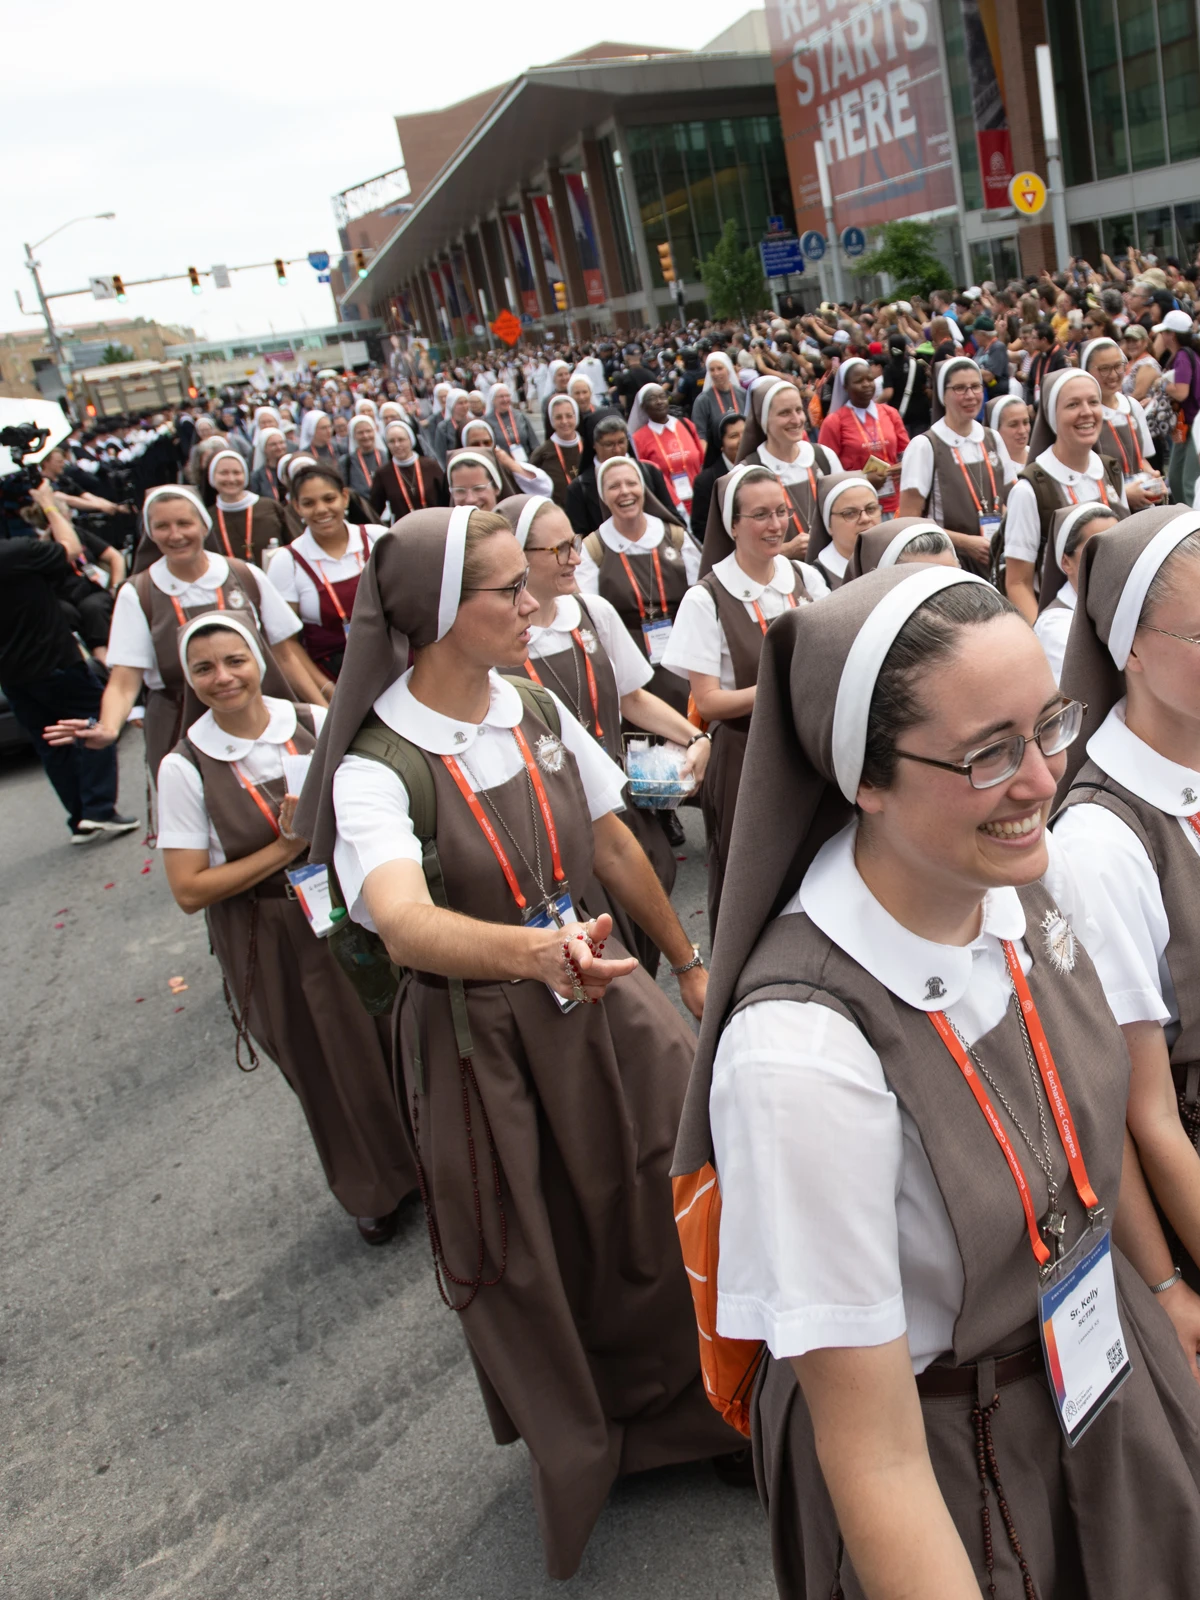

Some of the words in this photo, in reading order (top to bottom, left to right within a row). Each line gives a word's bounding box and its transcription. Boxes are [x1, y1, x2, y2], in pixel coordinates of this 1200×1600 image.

[792, 0, 928, 107] STARTS
[817, 64, 917, 166] HERE
[481, 817, 496, 841] Congress
[493, 840, 508, 867] Eucharistic
[1038, 1042, 1050, 1069] NATIONAL
[1046, 1069, 1067, 1118] Eucharistic
[1062, 1118, 1078, 1159] Congress
[985, 1104, 1006, 1144] Congress
[1005, 1143, 1026, 1190] Eucharistic
[1070, 1307, 1081, 1320] Sr.
[1081, 1287, 1099, 1310] Kelly
